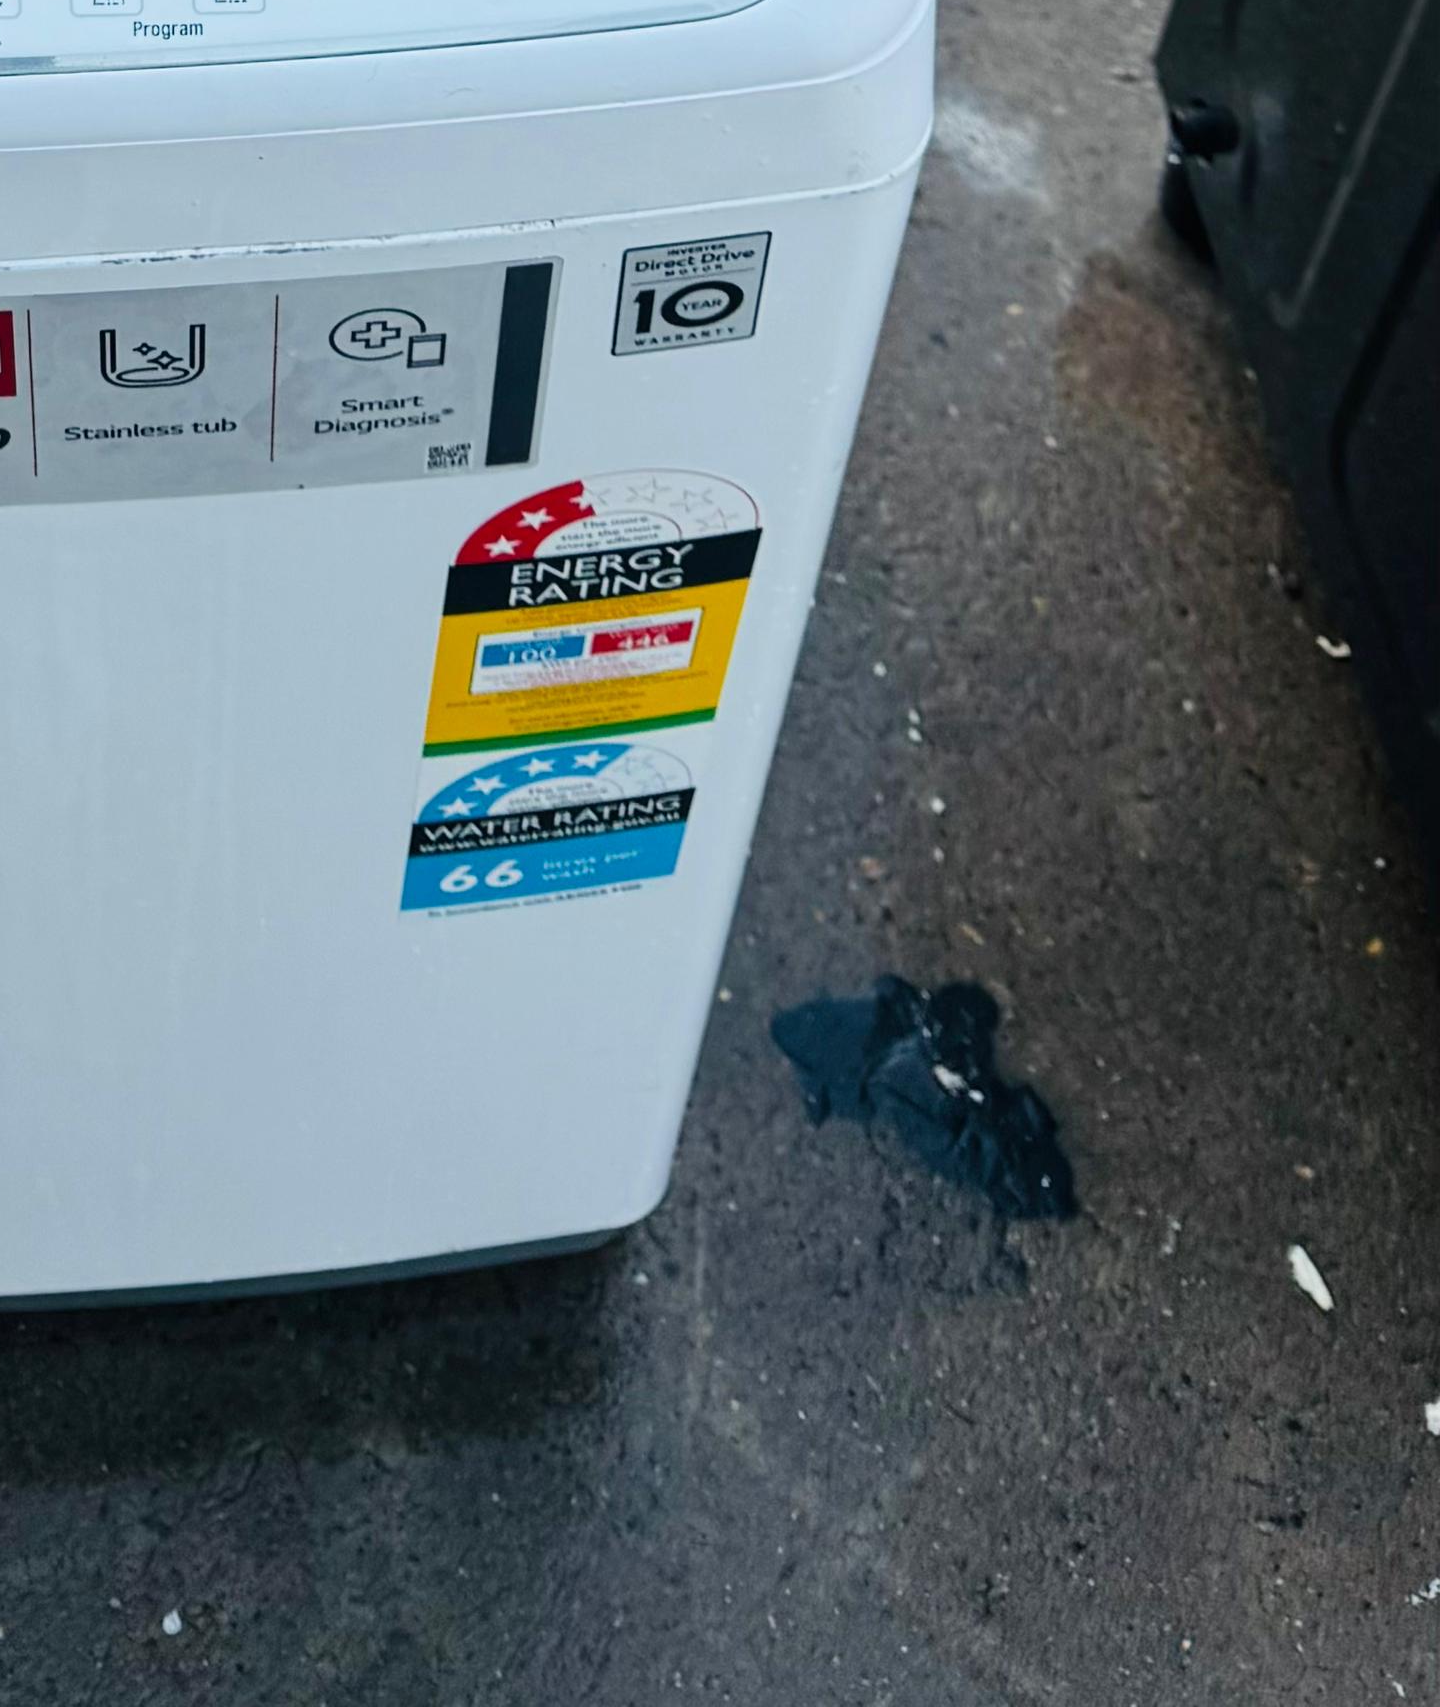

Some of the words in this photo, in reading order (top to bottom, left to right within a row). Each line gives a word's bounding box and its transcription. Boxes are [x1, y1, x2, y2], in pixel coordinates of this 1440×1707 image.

[133, 21, 204, 39] Program
[635, 256, 695, 273] Direct
[701, 249, 755, 263] Drive
[667, 243, 726, 256] INVERTER
[633, 280, 744, 335] 10
[681, 298, 723, 312] YEAR
[342, 394, 425, 413] Smart
[65, 418, 184, 442] Stainless
[192, 417, 237, 435] tub
[510, 544, 694, 585] ENERGY
[509, 568, 684, 607] RATING
[423, 815, 542, 841] WATER
[553, 794, 681, 826] RATING
[440, 860, 524, 893] 66
